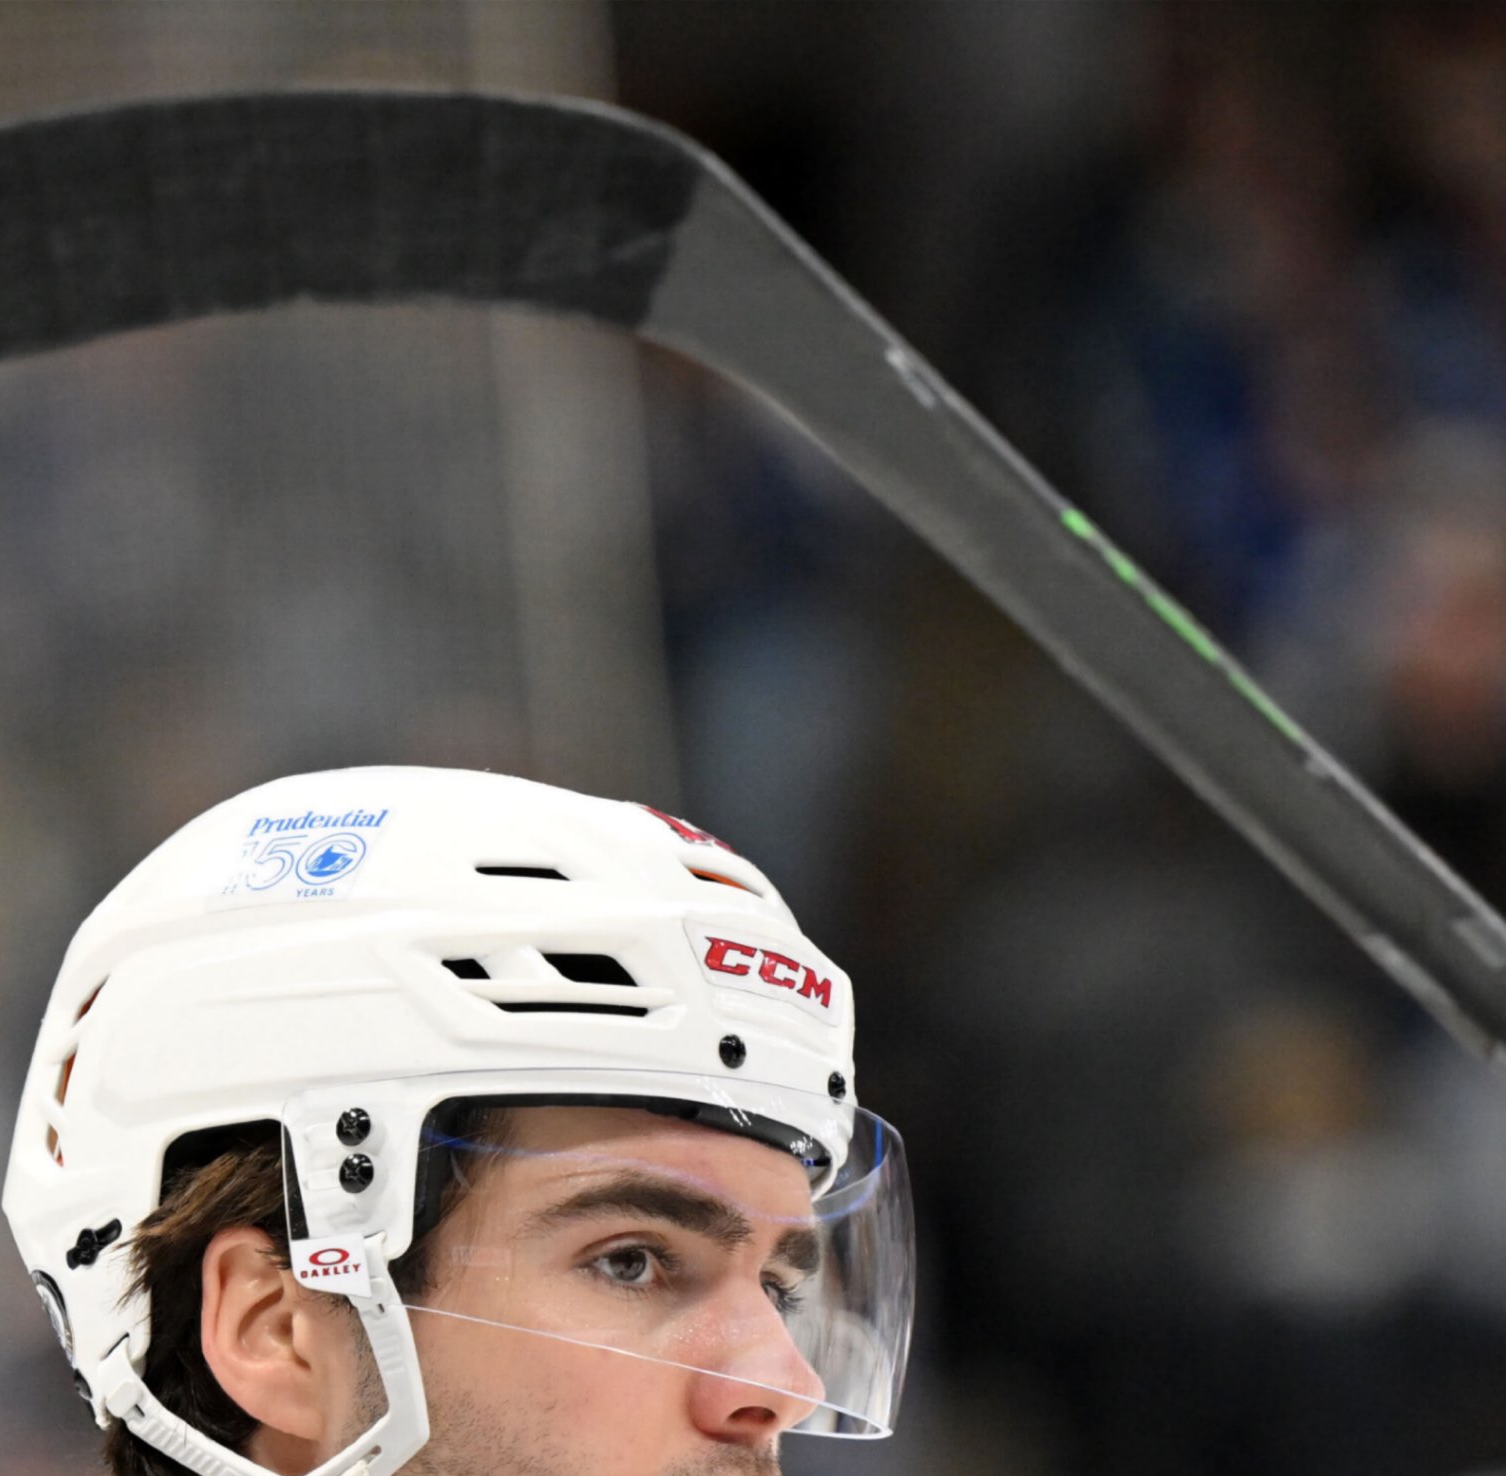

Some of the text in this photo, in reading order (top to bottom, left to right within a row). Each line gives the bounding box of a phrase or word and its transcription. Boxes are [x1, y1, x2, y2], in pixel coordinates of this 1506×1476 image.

[247, 809, 389, 837] Prudential
[295, 887, 335, 898] YEARS
[704, 936, 833, 1009] CCM
[300, 1263, 362, 1279] OAKLEY
